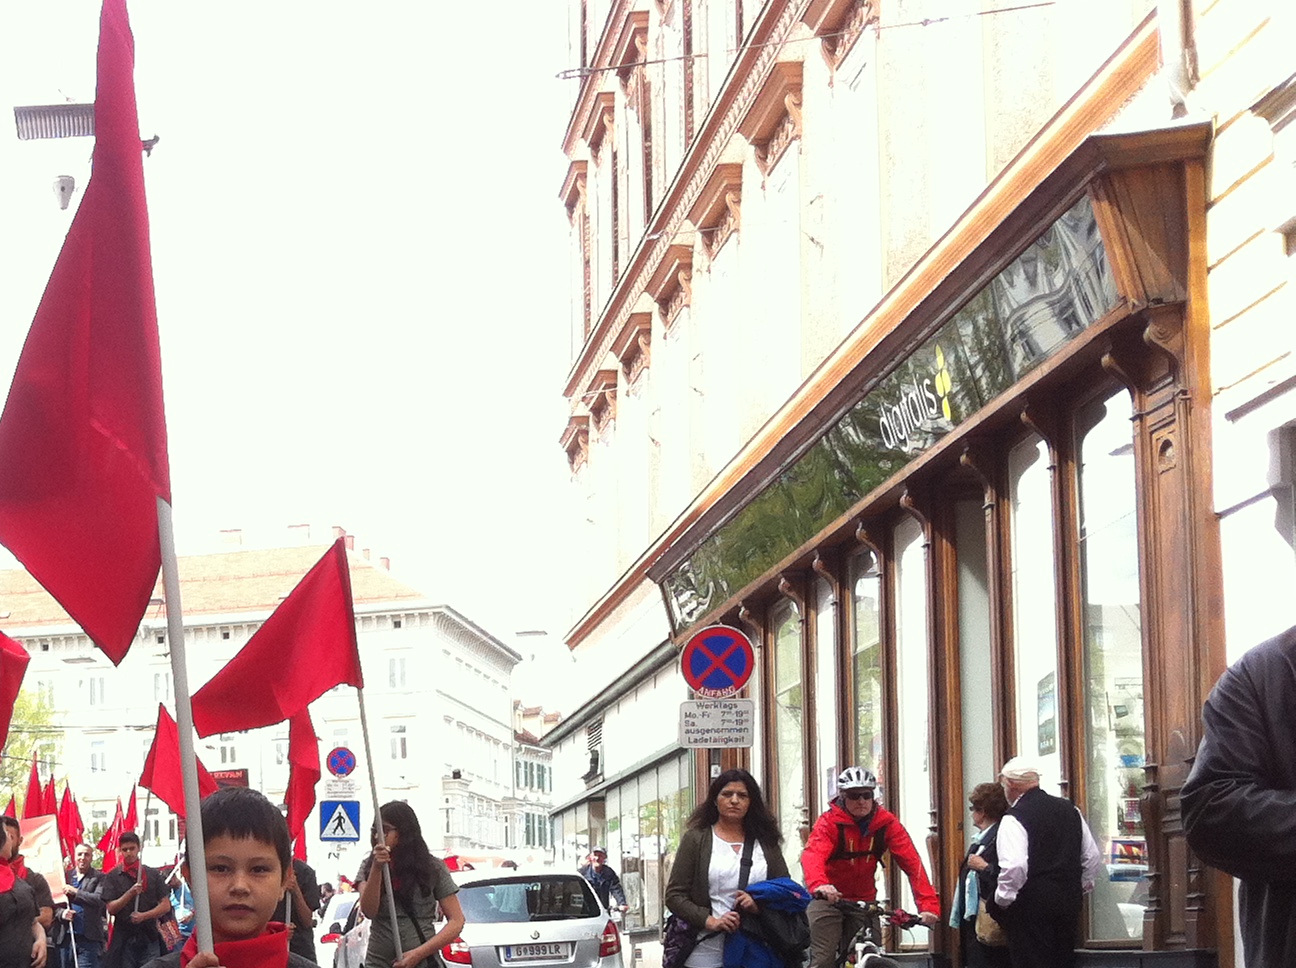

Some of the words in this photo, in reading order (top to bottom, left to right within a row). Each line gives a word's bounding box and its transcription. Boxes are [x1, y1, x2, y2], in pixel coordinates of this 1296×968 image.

[879, 373, 937, 453] digitalis
[698, 686, 736, 696] ANFANG
[696, 702, 738, 710] Werktags
[684, 727, 749, 735] ausgenommen
